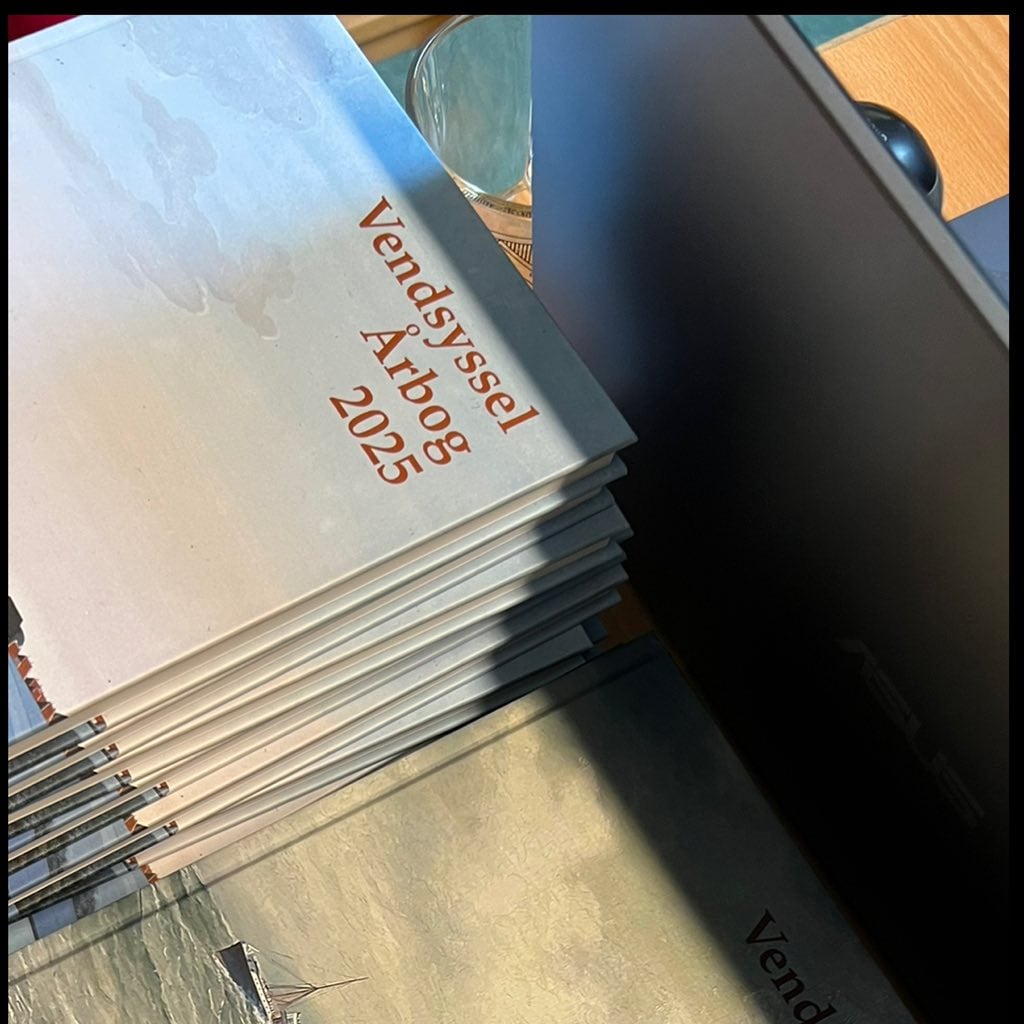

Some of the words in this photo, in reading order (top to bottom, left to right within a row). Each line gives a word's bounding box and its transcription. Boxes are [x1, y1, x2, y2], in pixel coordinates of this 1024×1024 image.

[359, 196, 541, 435] Vendsyssel
[329, 385, 423, 485] 2025
[360, 323, 473, 466] Årbog
